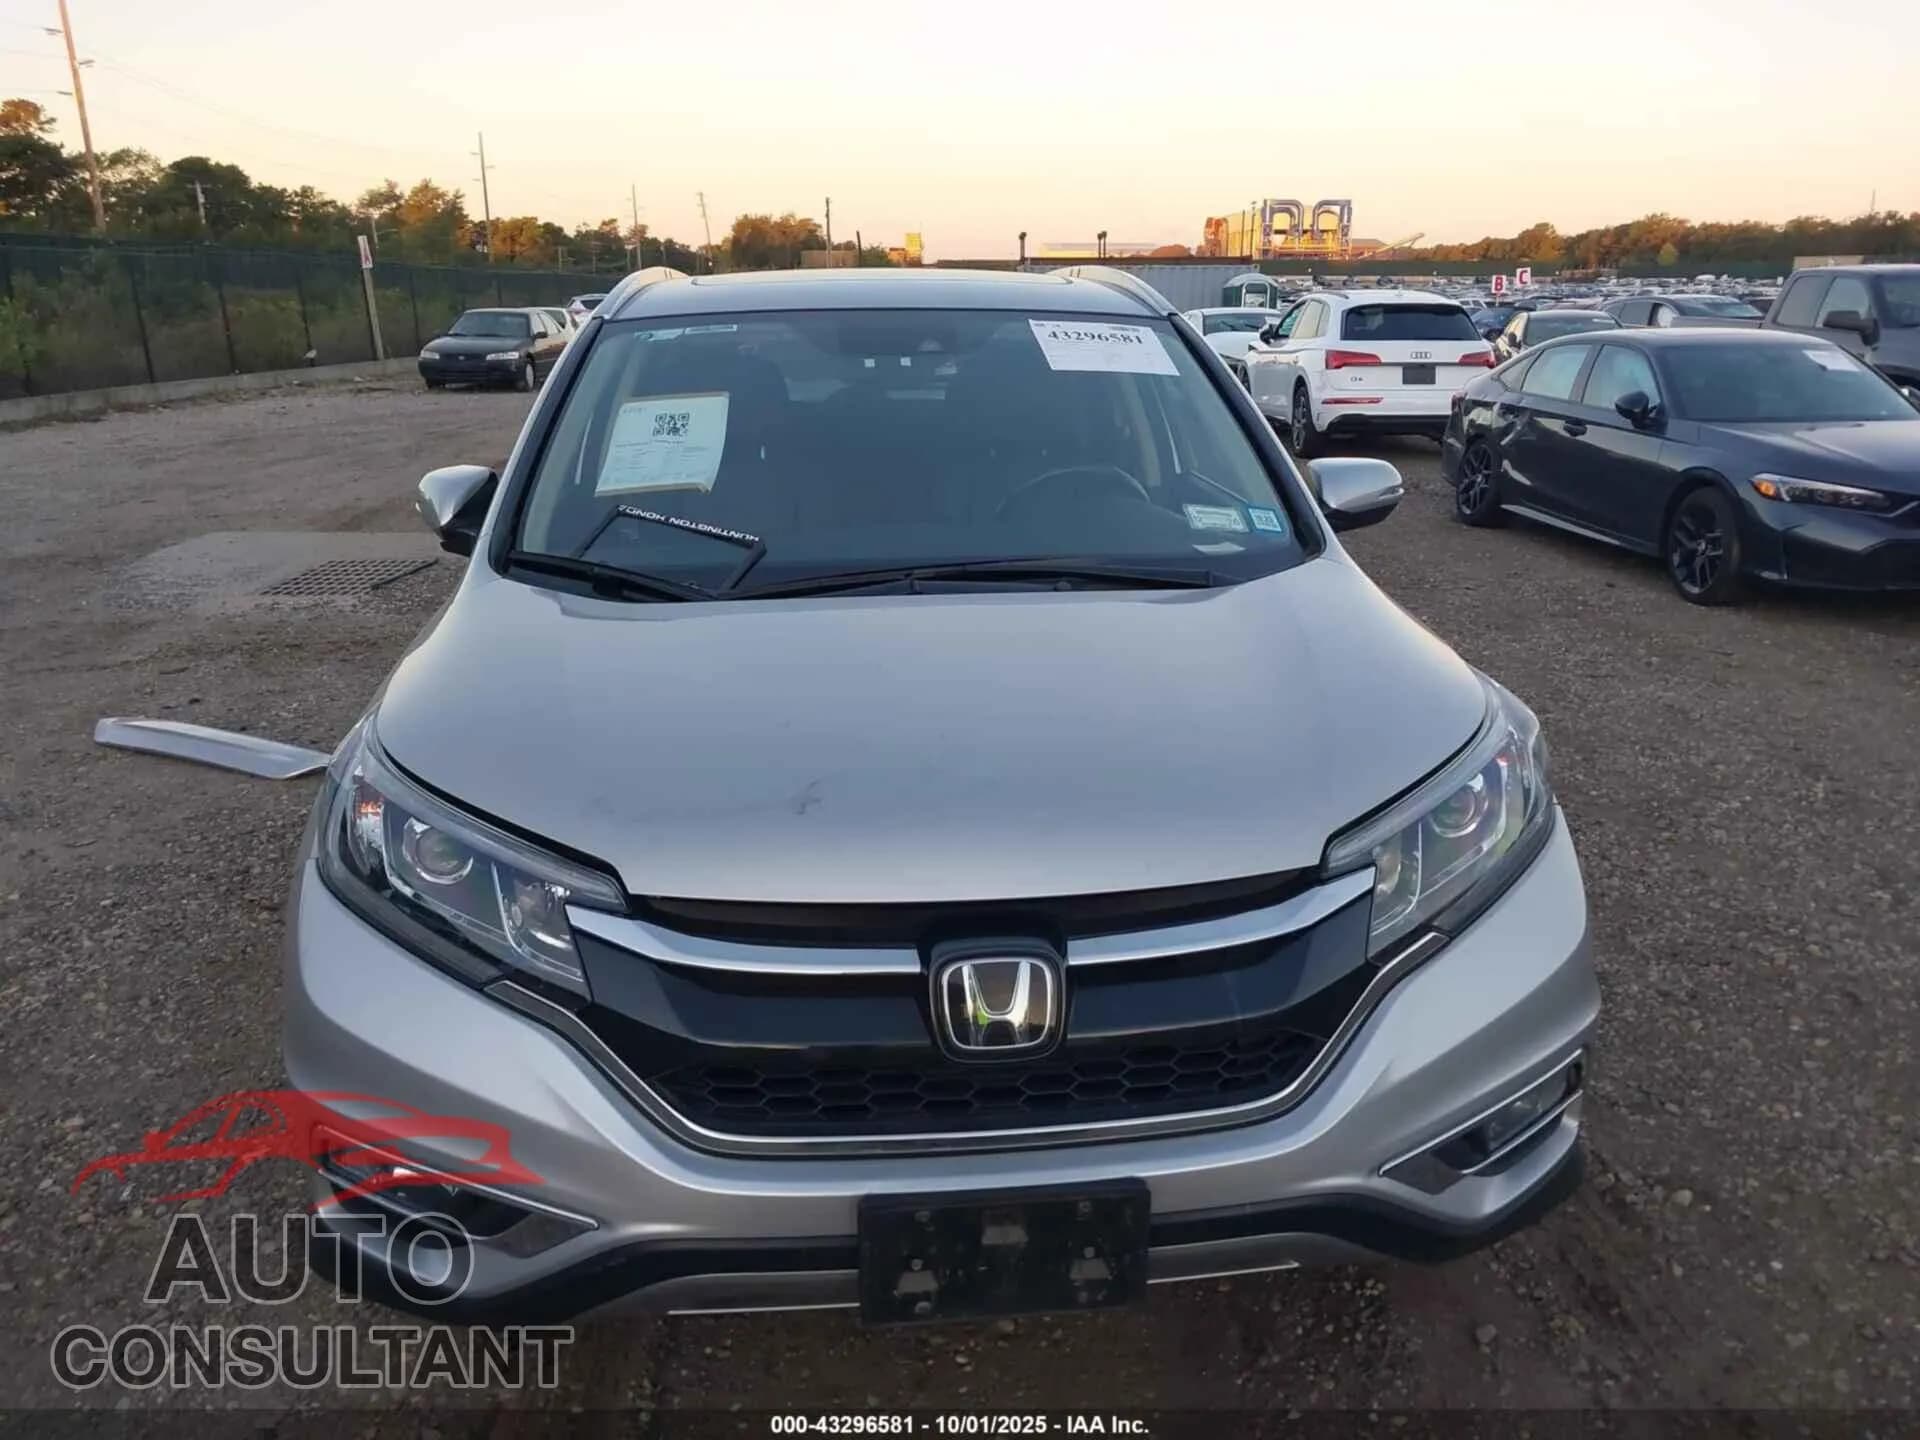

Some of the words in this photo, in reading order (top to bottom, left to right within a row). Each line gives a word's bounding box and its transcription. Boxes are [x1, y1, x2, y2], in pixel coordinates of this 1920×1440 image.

[1494, 275, 1504, 292] B
[1518, 269, 1529, 285] C
[1048, 330, 1144, 345] 43296581
[668, 517, 760, 542] HUNTINGTON
